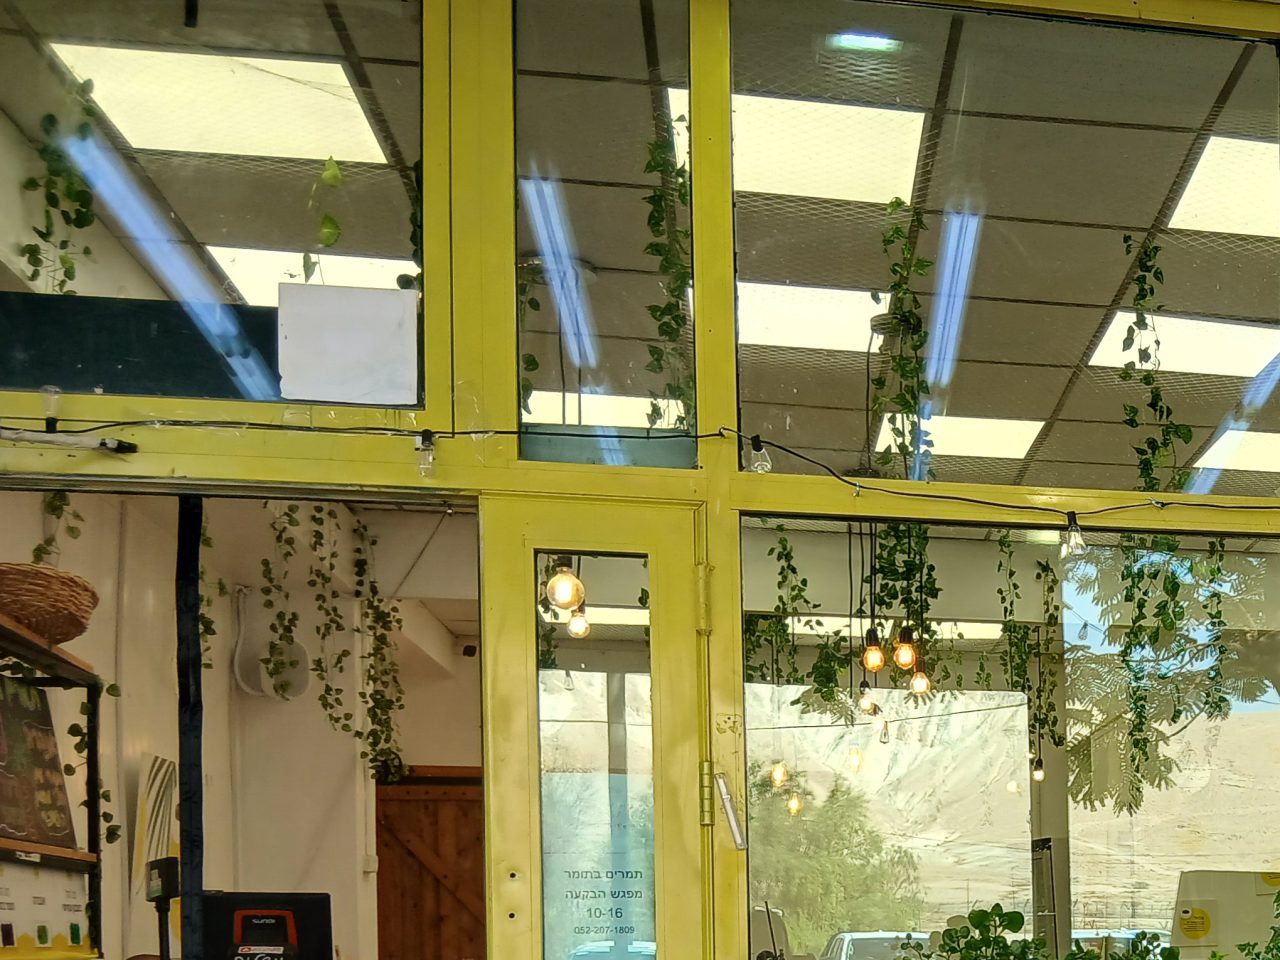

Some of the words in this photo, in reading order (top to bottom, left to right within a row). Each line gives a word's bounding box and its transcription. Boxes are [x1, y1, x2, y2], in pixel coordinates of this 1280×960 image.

[564, 870, 601, 879] בתומר
[605, 870, 643, 879] תמרים
[565, 890, 606, 901] הבקעה
[610, 890, 643, 899] מפגש
[586, 907, 623, 918] 10-16
[574, 926, 635, 934] 052-207-1809
